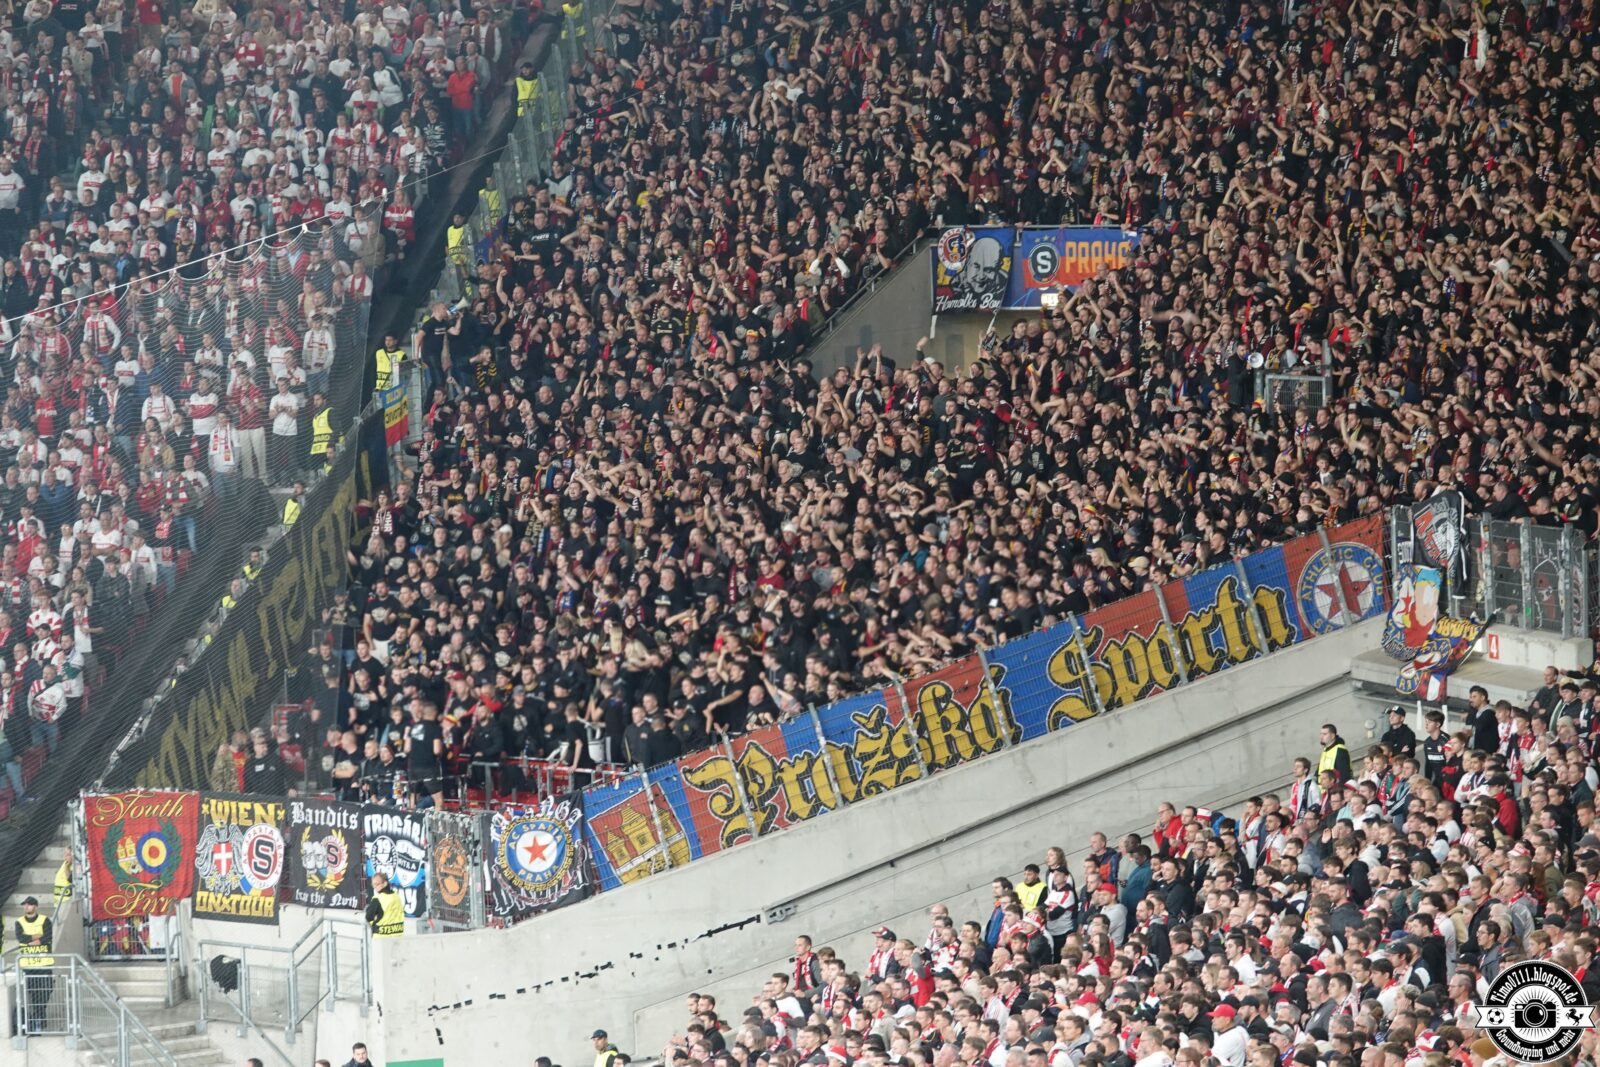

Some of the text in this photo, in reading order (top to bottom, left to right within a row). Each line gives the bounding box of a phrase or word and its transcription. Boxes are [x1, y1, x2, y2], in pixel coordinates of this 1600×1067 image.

[1065, 241, 1130, 273] PRAHA
[1363, 556, 1384, 596] CLUB
[1046, 575, 1297, 733] Sparta
[1490, 635, 1498, 657] 4
[92, 791, 189, 827] Youth
[209, 799, 276, 828] WIEN
[290, 801, 359, 830] Bandits
[508, 822, 563, 850] AC SPARTA
[517, 863, 560, 883] PRAHA
[329, 893, 359, 909] North
